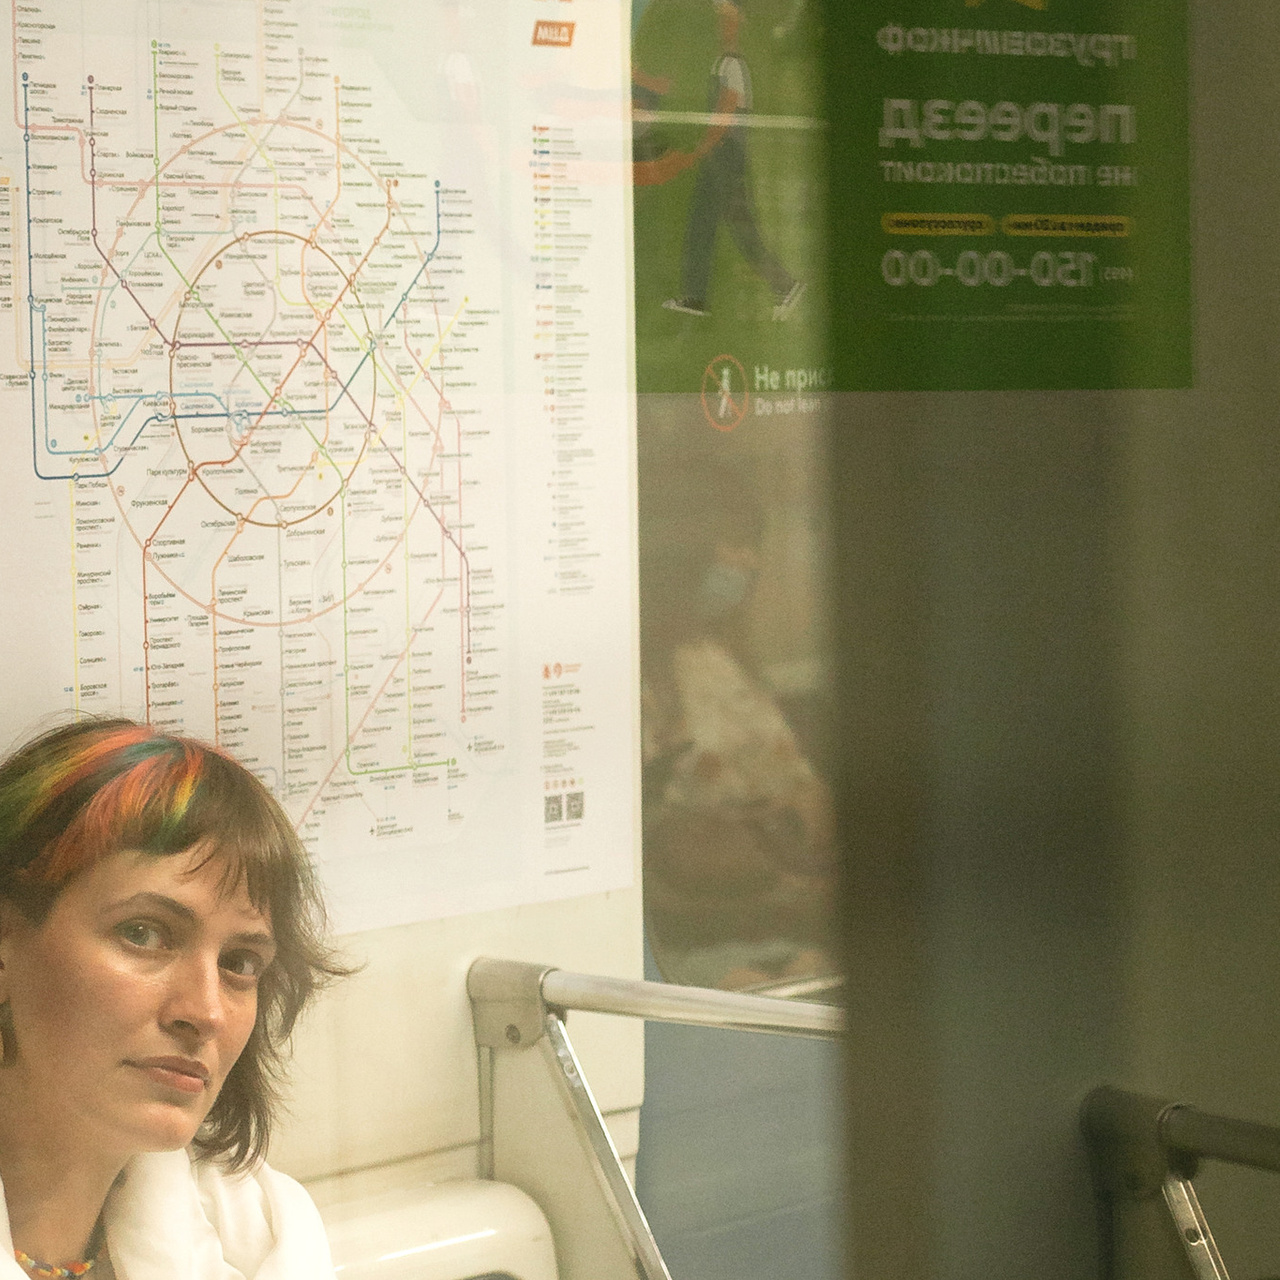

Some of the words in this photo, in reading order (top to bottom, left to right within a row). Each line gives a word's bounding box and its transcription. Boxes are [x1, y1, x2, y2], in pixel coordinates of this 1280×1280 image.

[754, 366, 781, 391] Не
[785, 367, 833, 399] прис
[754, 397, 773, 416] Do
